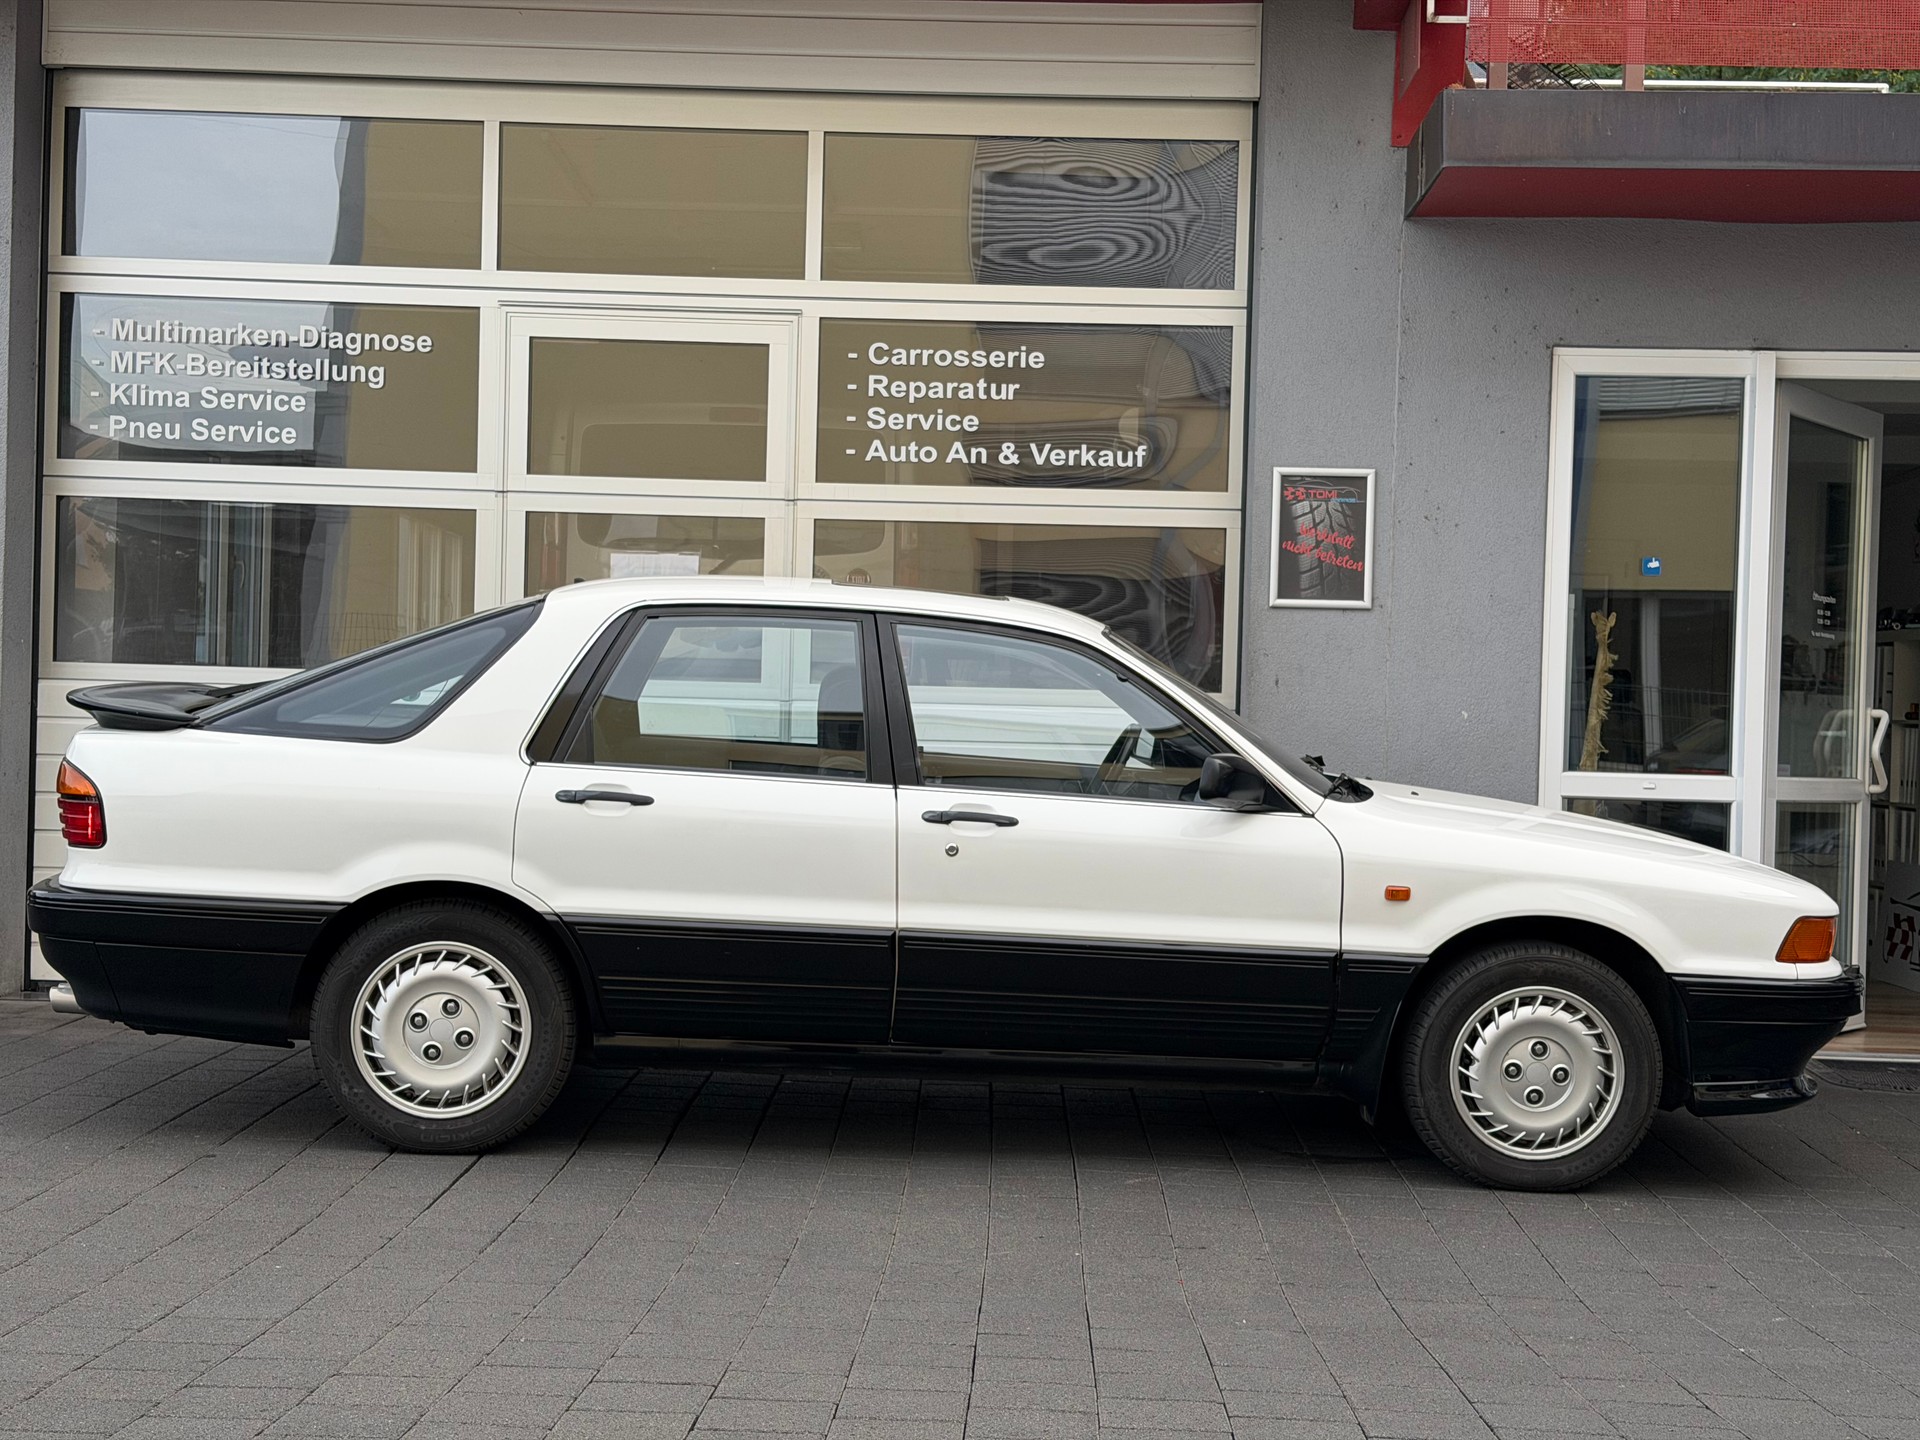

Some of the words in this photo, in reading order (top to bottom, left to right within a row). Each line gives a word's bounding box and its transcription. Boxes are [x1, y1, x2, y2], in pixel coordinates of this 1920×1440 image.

[111, 318, 433, 355] Multimarken-Diagnose
[110, 351, 386, 388] MFK-Bereitstellung
[868, 342, 1045, 369] Carrosserie
[109, 383, 190, 409] Klima
[200, 386, 307, 412] Service
[867, 374, 1020, 403] Reparatur
[108, 415, 181, 440] Pneu
[190, 418, 297, 444] Service
[866, 407, 980, 432] Service
[865, 439, 937, 464] Auto
[946, 440, 987, 464] An
[998, 442, 1020, 465] &
[1029, 442, 1148, 468] Verkauf
